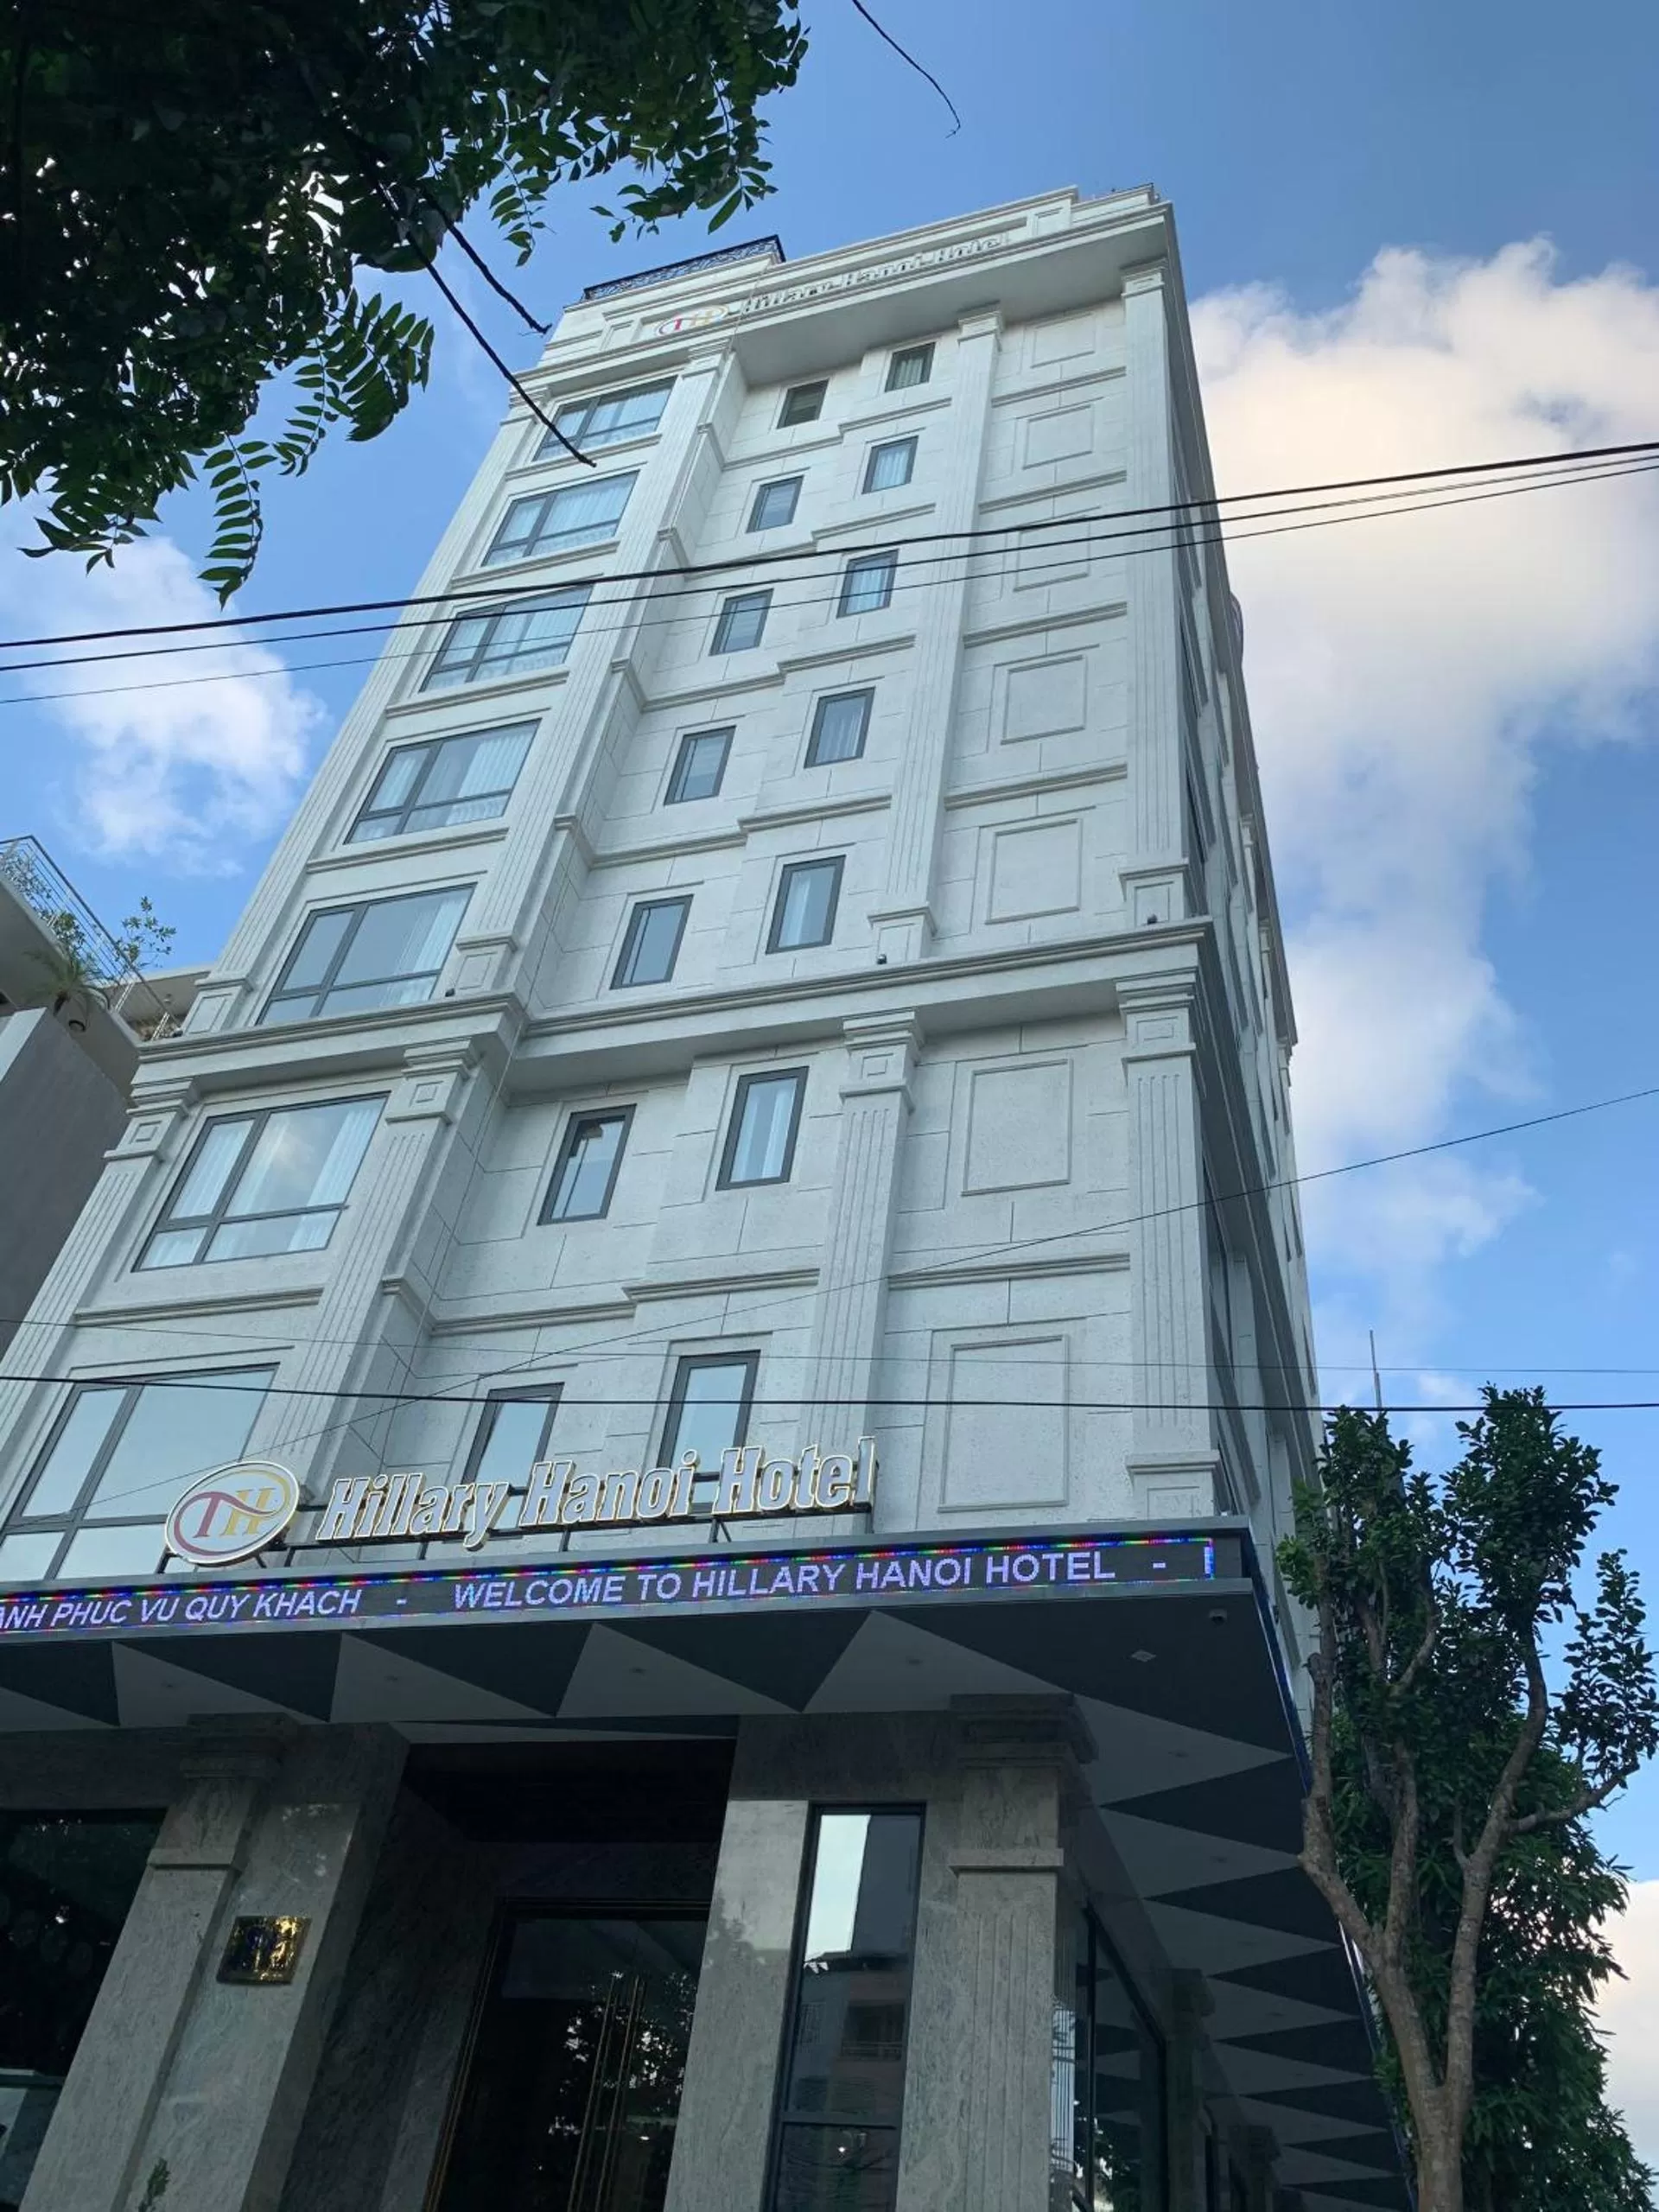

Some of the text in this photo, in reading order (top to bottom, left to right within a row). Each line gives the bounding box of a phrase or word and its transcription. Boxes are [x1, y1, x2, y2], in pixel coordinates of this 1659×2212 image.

[316, 1472, 510, 1550] Hillary
[520, 1449, 696, 1529] Hanoi
[711, 1435, 876, 1516] Hotel
[50, 1599, 132, 1627] PHUC
[140, 1598, 180, 1623] VU
[185, 1593, 251, 1621] QUY
[253, 1589, 362, 1618] KHACH
[454, 1574, 623, 1609] WELCOME
[638, 1572, 682, 1600] TO
[691, 1562, 847, 1599] HILLARY
[855, 1558, 972, 1590] HANOI
[985, 1550, 1116, 1584] HOTEL
